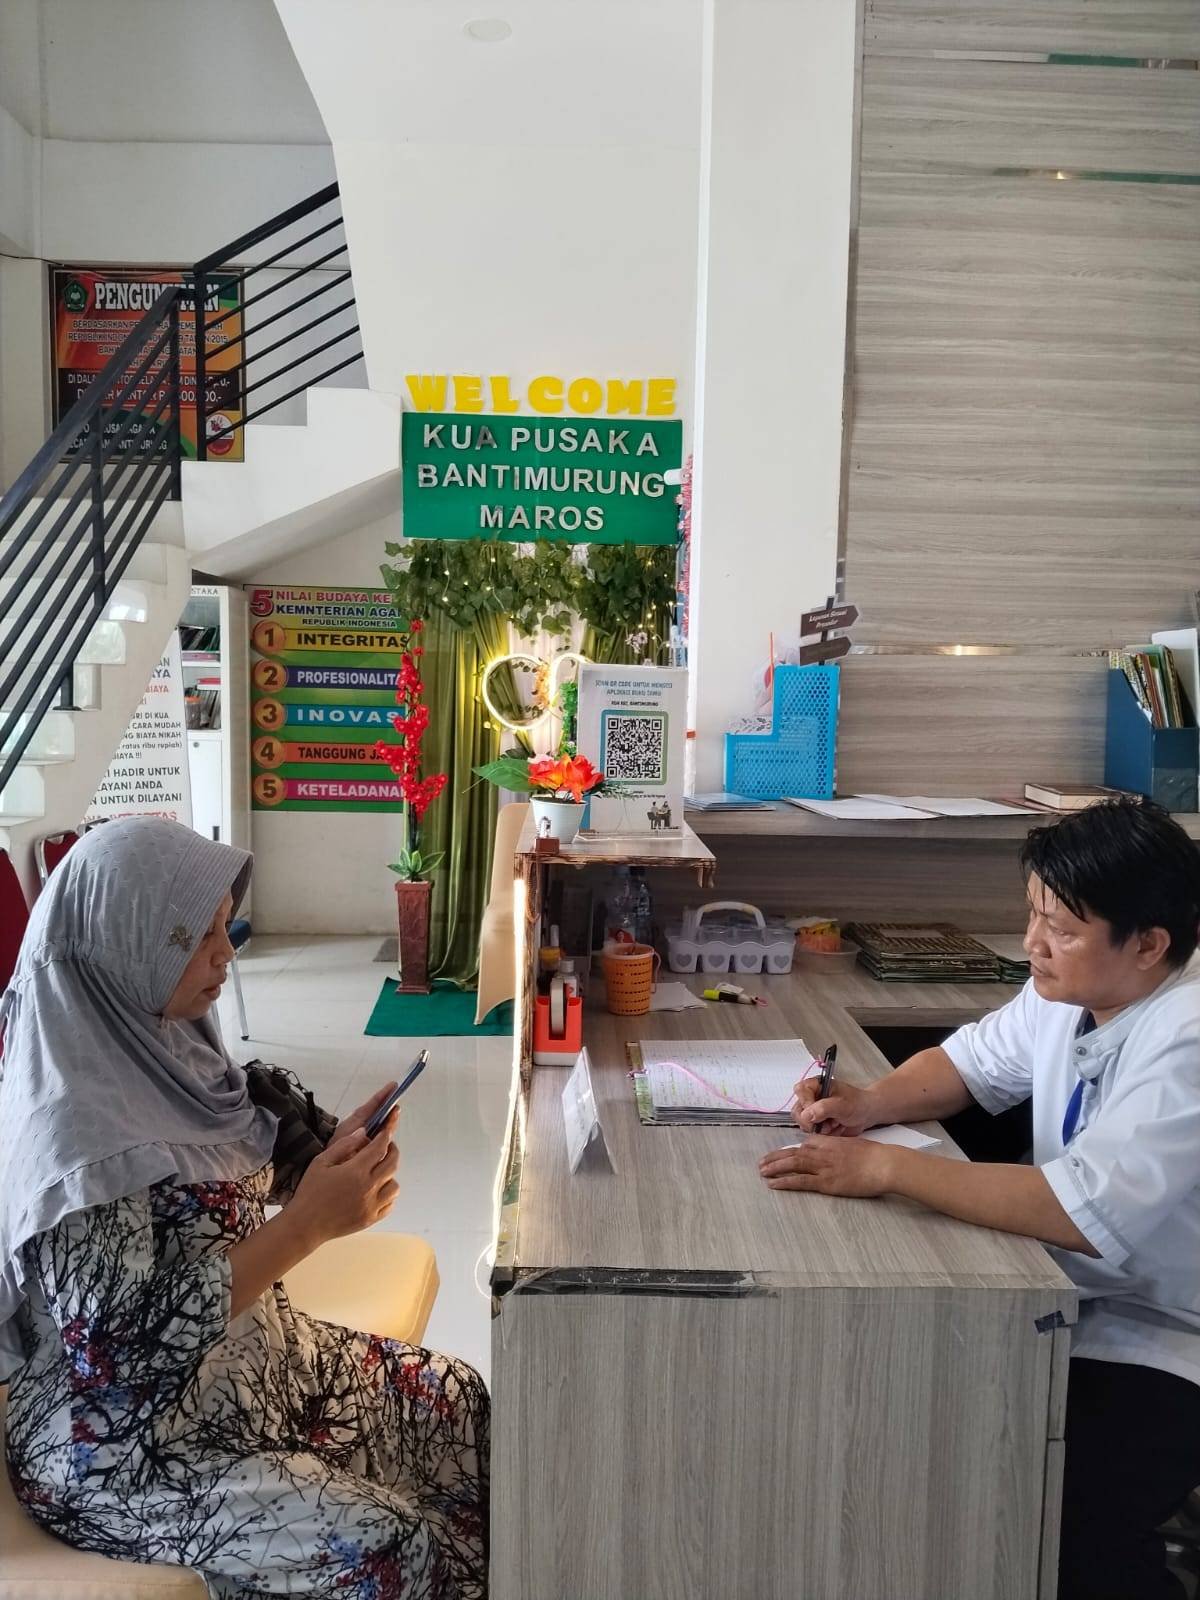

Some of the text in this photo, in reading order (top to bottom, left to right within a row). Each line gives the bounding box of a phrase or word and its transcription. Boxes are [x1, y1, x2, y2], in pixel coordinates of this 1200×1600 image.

[68, 374, 75, 383] DI
[77, 374, 96, 383] DALA
[405, 375, 677, 416] WELCOME
[423, 424, 659, 456] KUA PUSAKA
[418, 463, 665, 498] BANTIMURUNG
[480, 505, 604, 530] MAROS
[251, 589, 274, 617] 5
[276, 591, 311, 601] NILAI
[316, 592, 368, 602] BUDAYA
[276, 605, 401, 617] KEMNTERIAN AGA
[302, 618, 346, 626] REPUBLIK
[264, 628, 408, 648] 1 INTEGRITAS
[263, 666, 278, 686] 2
[263, 704, 399, 723] 3 INOVAS
[260, 742, 275, 761] 4
[298, 747, 366, 760] TANGGUNG
[113, 768, 145, 777] HADIR
[147, 767, 180, 776] UNTUK
[135, 780, 163, 789] ANDA
[263, 779, 404, 798] 5 KETELADANA
[101, 794, 135, 805] UNTUK
[138, 793, 182, 803] DILAYANI
